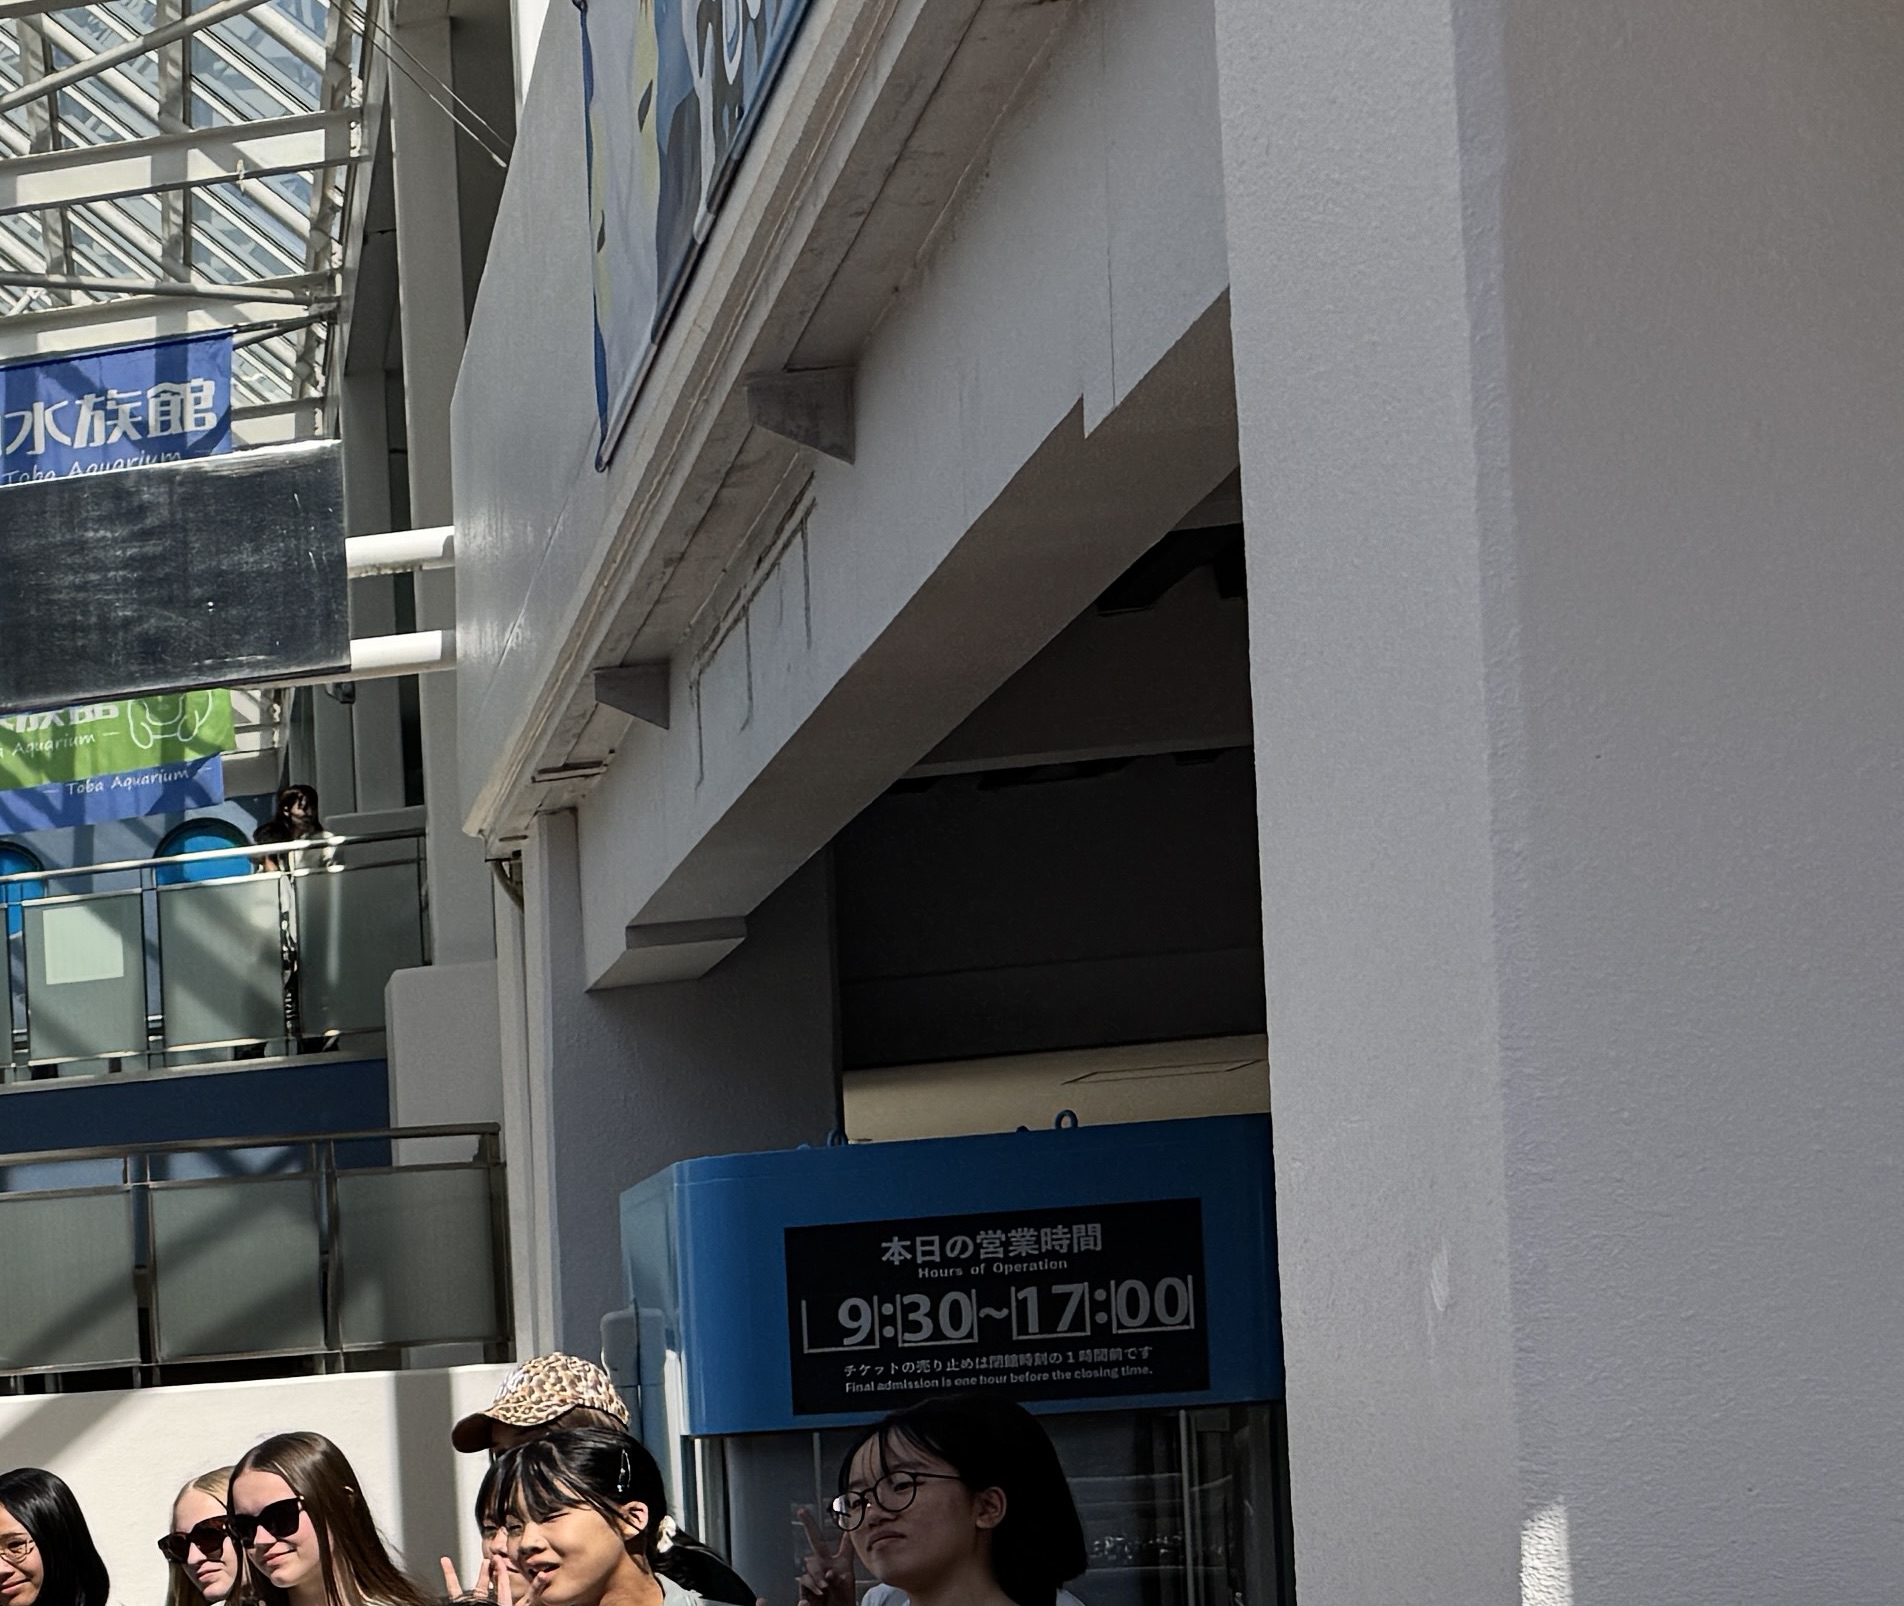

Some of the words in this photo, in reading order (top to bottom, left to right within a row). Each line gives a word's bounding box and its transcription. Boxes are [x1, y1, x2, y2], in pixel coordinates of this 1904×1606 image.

[12, 734, 96, 759] Aquarium
[65, 779, 104, 797] Toba
[111, 767, 190, 791] Aquarium
[880, 1222, 1103, 1267] 本日の営業時間
[917, 1265, 963, 1279] Hours
[970, 1263, 986, 1276] of
[992, 1258, 1068, 1277] Operation
[845, 1380, 875, 1393] Final
[877, 1377, 939, 1392] admission
[941, 1376, 953, 1389] is
[956, 1376, 977, 1388] one
[979, 1372, 1008, 1386] hour
[1010, 1369, 1049, 1384] before
[1052, 1368, 1072, 1381] the
[1074, 1366, 1119, 1382] closing
[1121, 1364, 1154, 1378] time.
